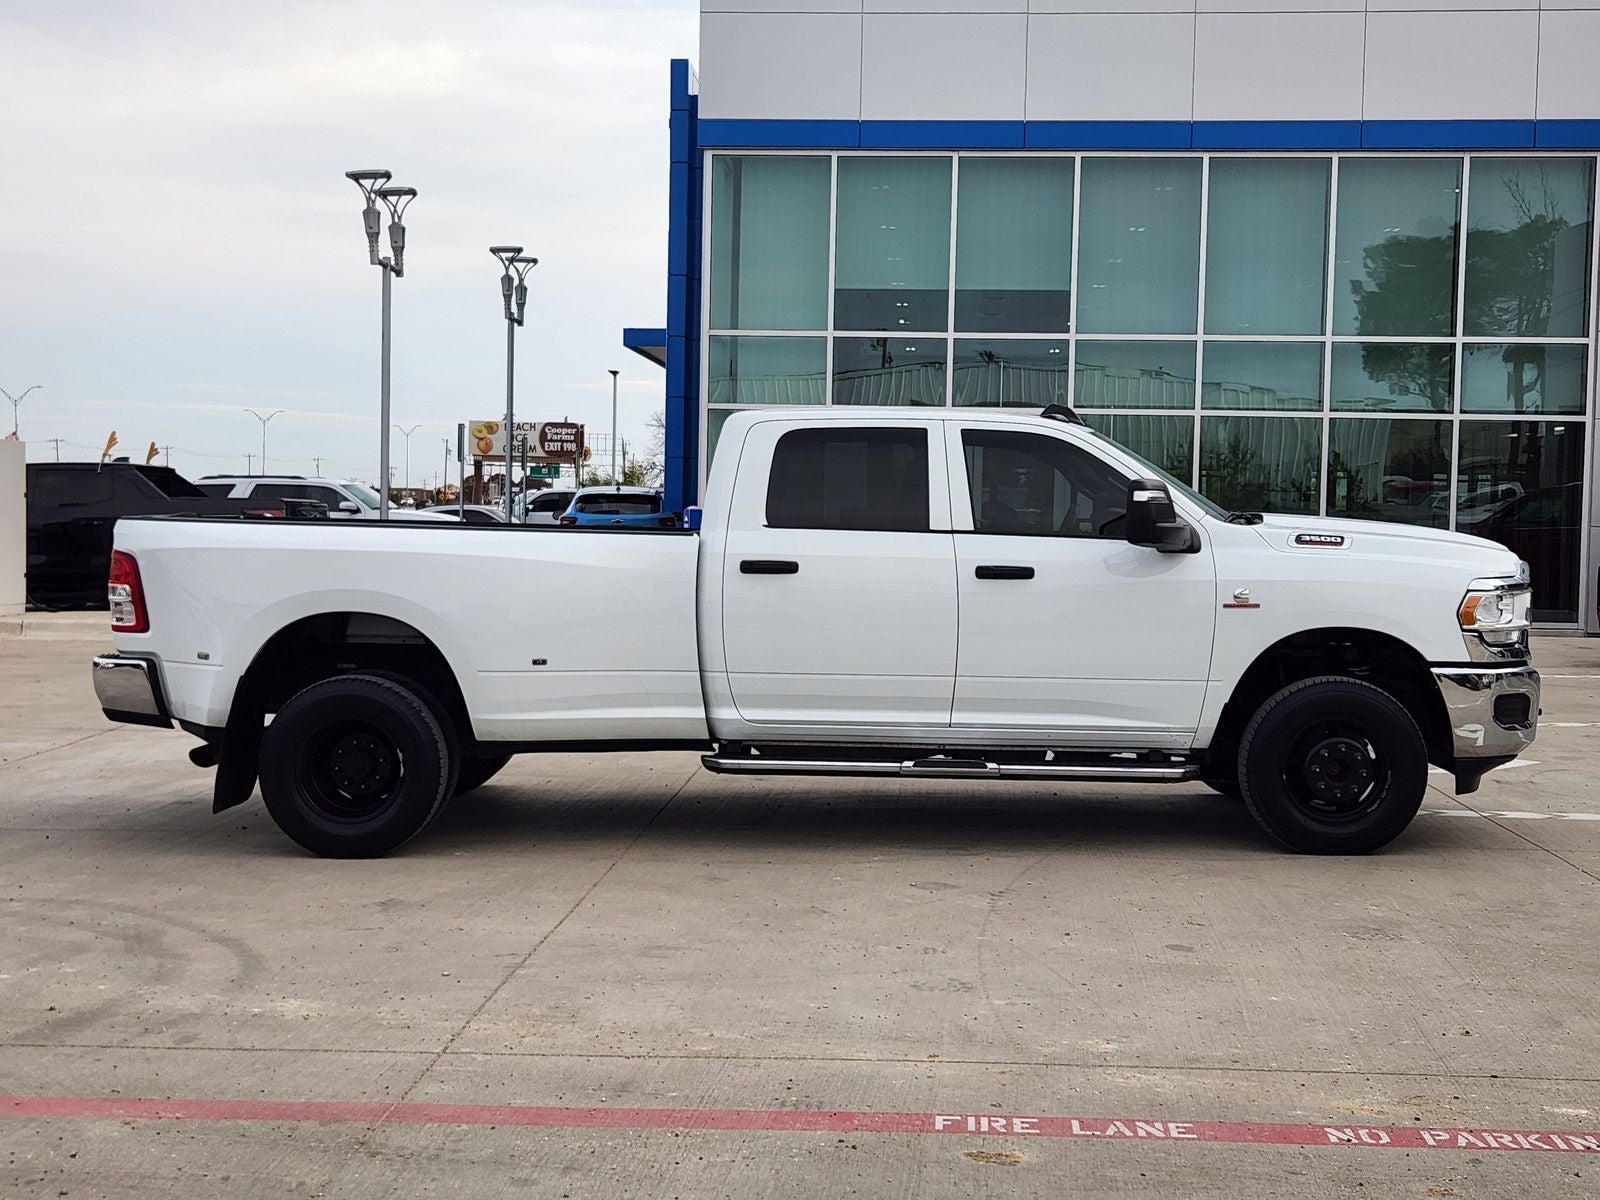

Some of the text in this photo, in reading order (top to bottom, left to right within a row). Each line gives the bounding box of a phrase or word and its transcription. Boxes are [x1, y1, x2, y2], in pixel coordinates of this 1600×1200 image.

[504, 422, 536, 432] EACH
[545, 426, 577, 434] Cooper
[547, 433, 575, 441] Farms
[502, 444, 537, 454] REM
[544, 442, 577, 452] EXIT 198
[934, 1115, 1600, 1151] FIRE LANE NO PARKIN
